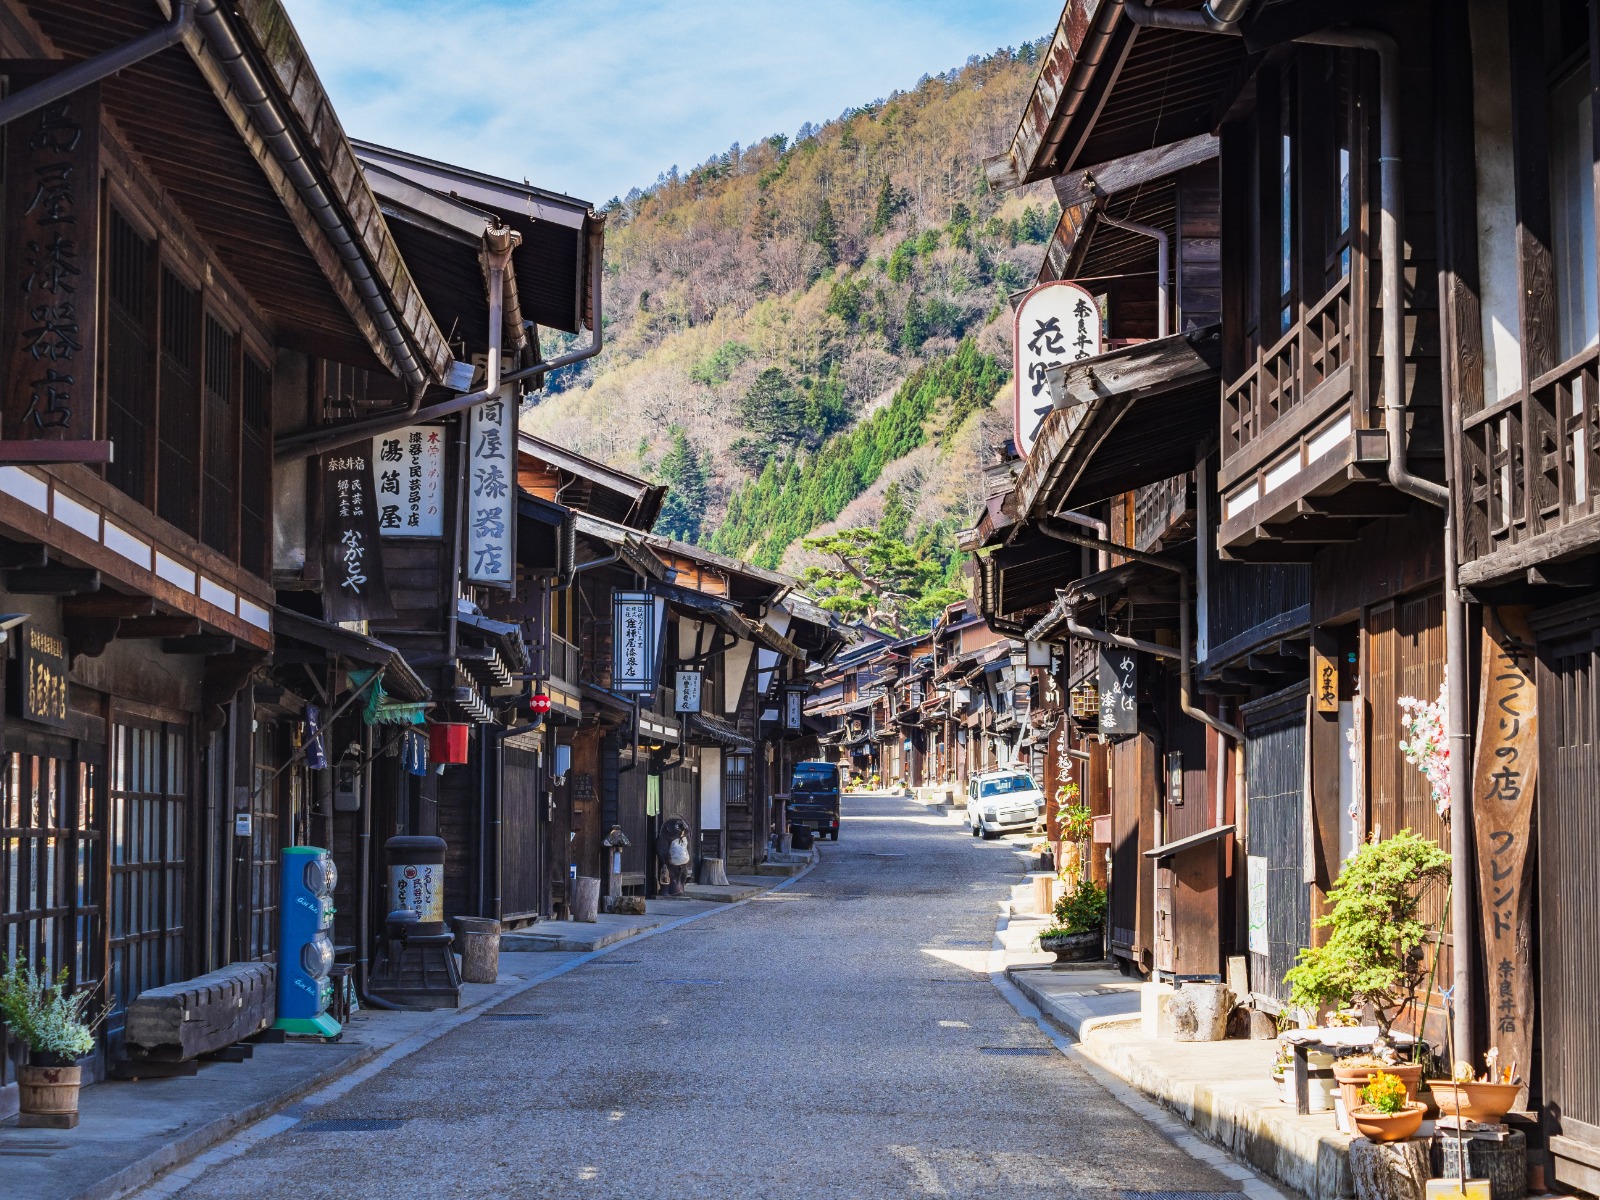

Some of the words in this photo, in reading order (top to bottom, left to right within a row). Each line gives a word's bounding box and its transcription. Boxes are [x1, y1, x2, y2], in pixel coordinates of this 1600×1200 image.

[328, 457, 365, 471] 奈良井宿
[379, 438, 404, 529] 湯筒屋
[351, 479, 363, 516] 民芸品
[341, 529, 367, 594] ながとや
[1101, 689, 1117, 728] 漆の器
[1113, 681, 1121, 694] &
[1321, 665, 1336, 706] かまや
[1487, 636, 1530, 801] 手づくりの店
[1490, 831, 1514, 940] フレンド
[1497, 957, 1516, 1035] 奈良井宿
